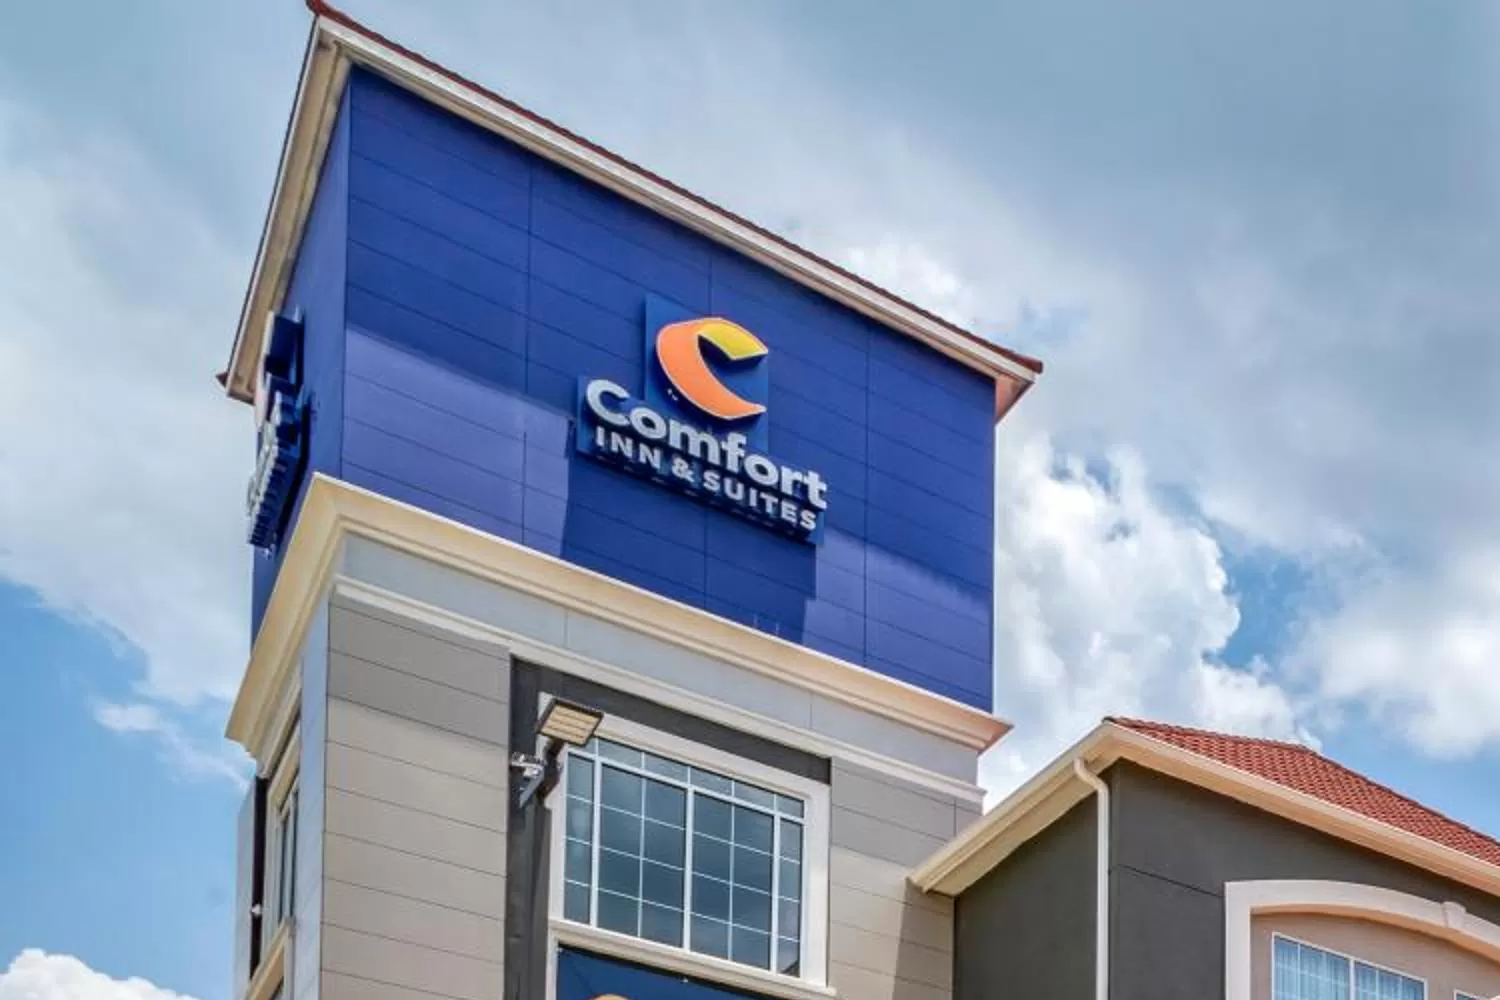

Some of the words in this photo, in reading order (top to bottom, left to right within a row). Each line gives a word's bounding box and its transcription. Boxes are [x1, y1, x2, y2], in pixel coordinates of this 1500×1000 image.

[586, 379, 828, 510] Comfort
[595, 426, 662, 470] INN
[671, 456, 696, 484] &
[702, 469, 818, 532] SUITES
